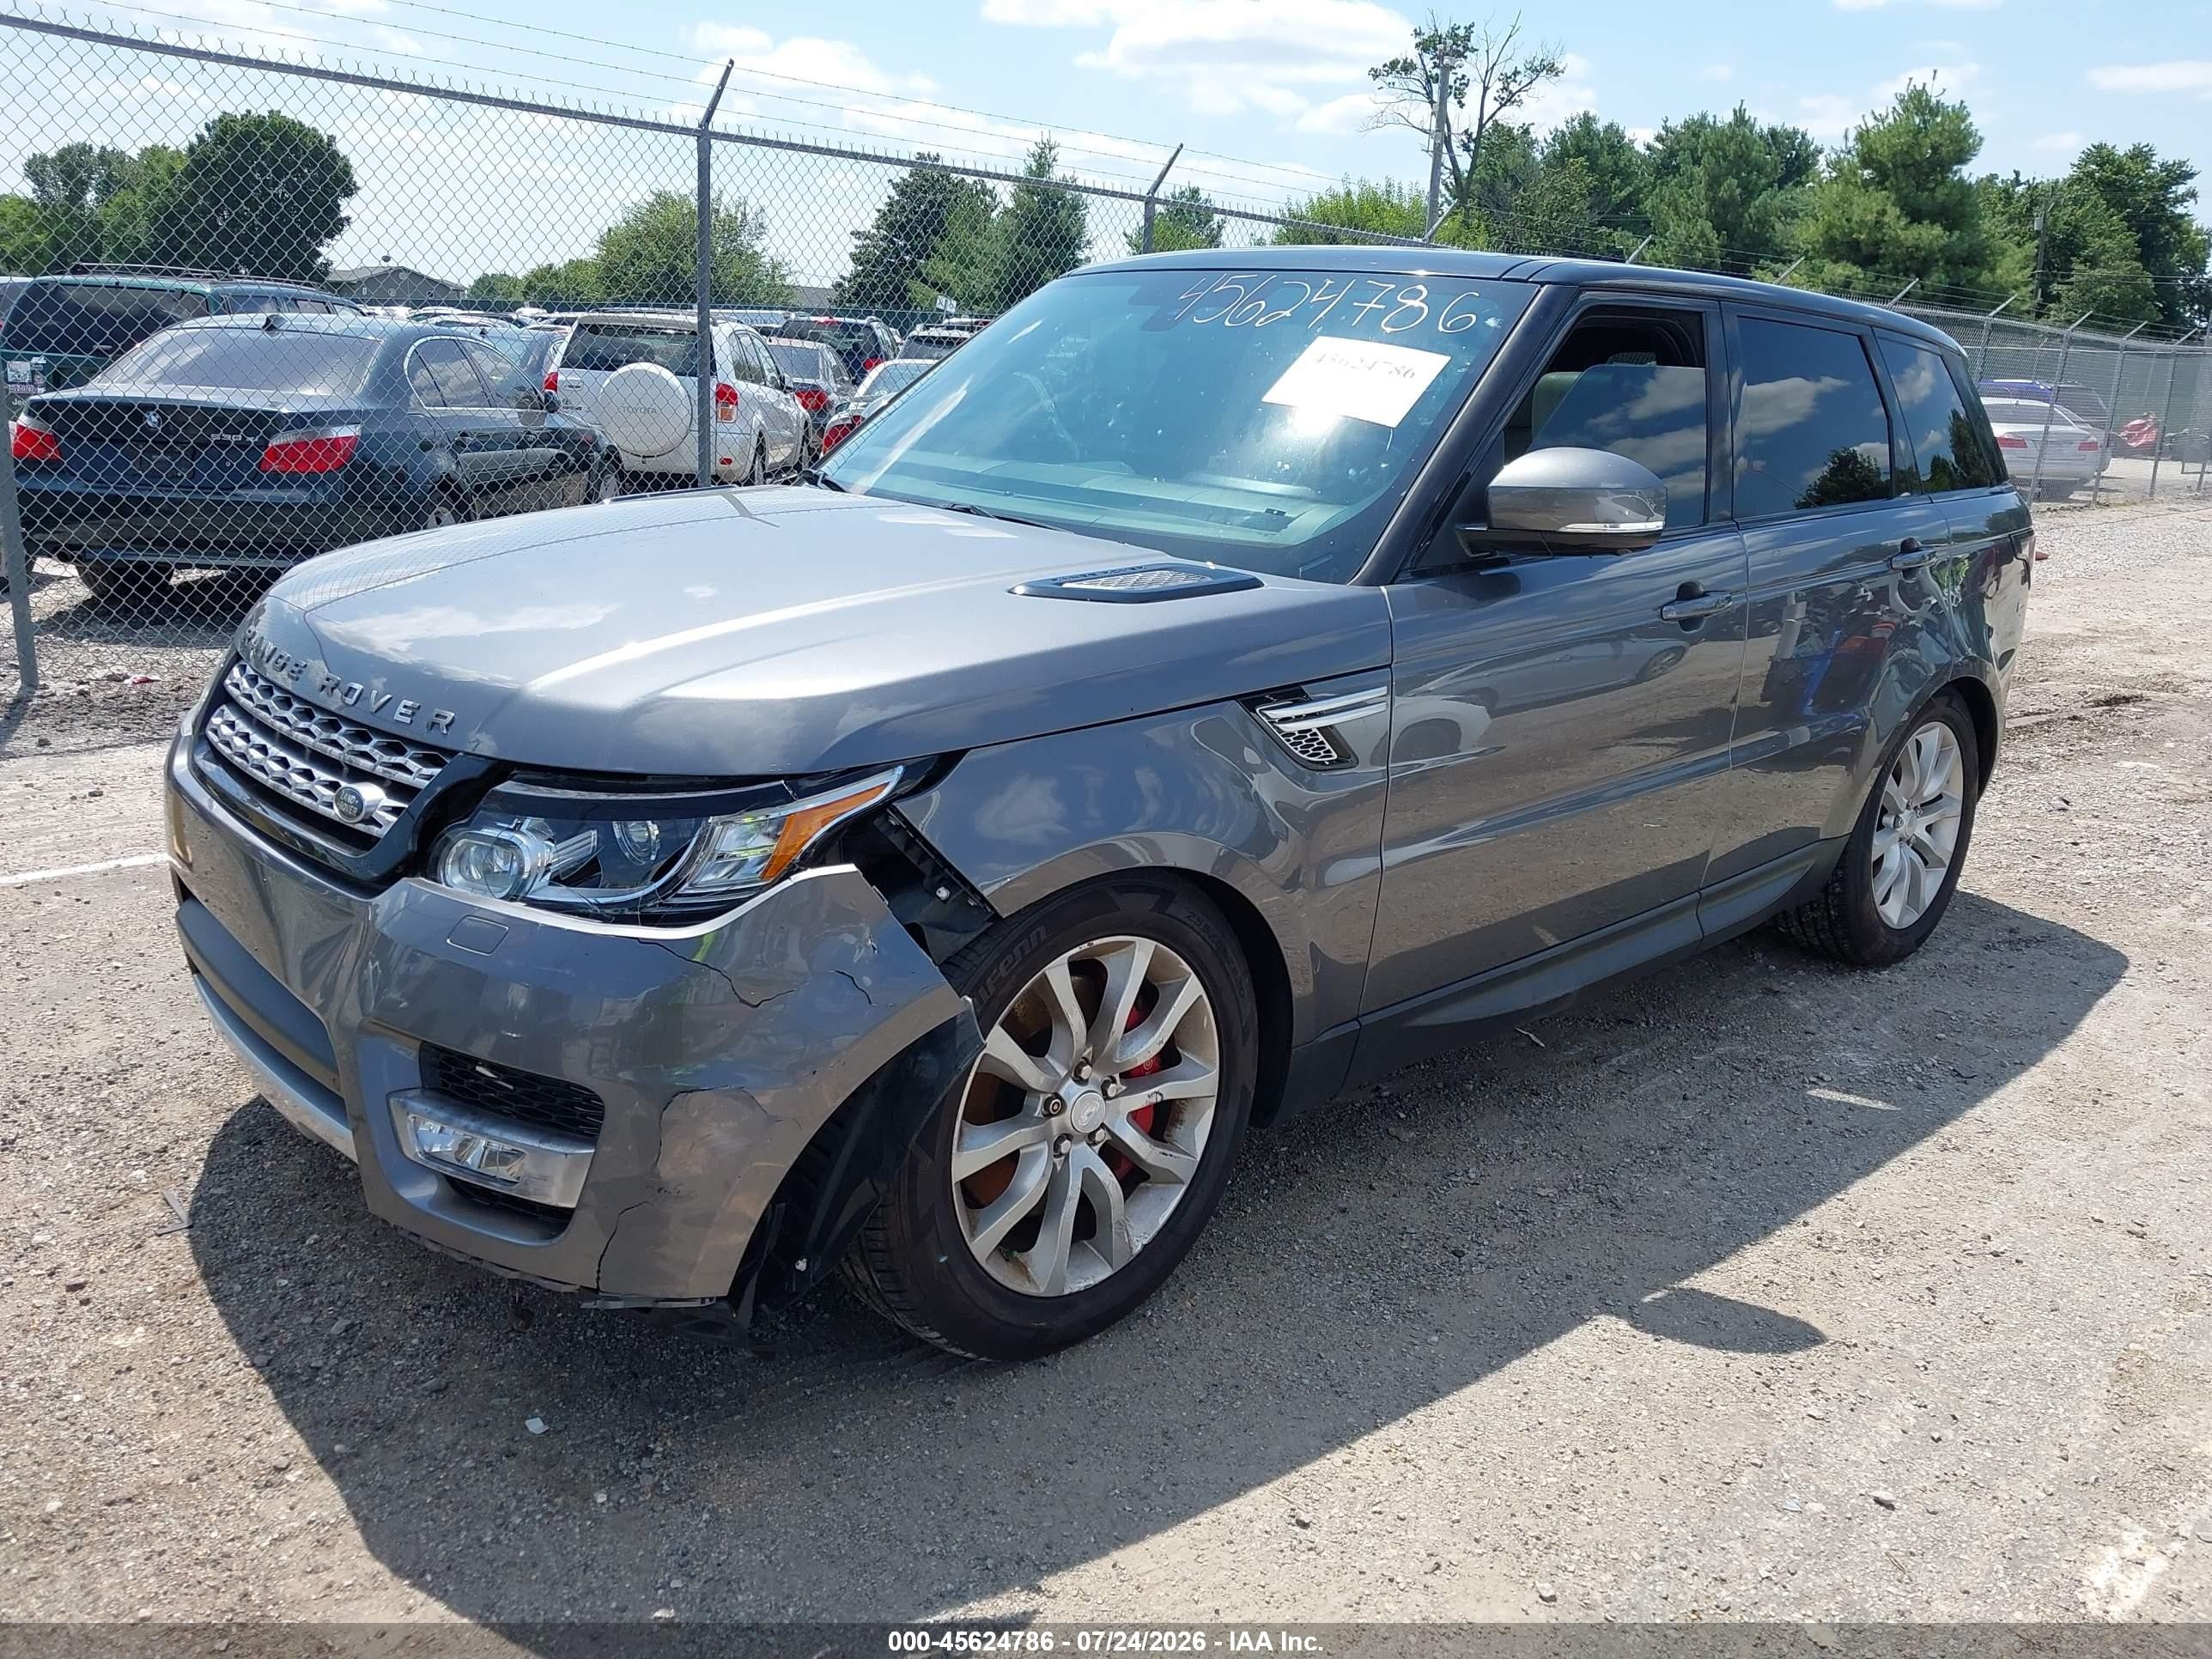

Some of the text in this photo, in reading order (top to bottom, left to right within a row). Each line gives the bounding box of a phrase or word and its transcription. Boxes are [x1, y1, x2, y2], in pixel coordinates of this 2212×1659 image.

[1174, 272, 1481, 334] 45624786
[622, 405, 658, 415] TOYOTA
[242, 625, 457, 736] RANGE ROVER
[340, 790, 356, 805] LAND
[337, 800, 358, 817] ROVER
